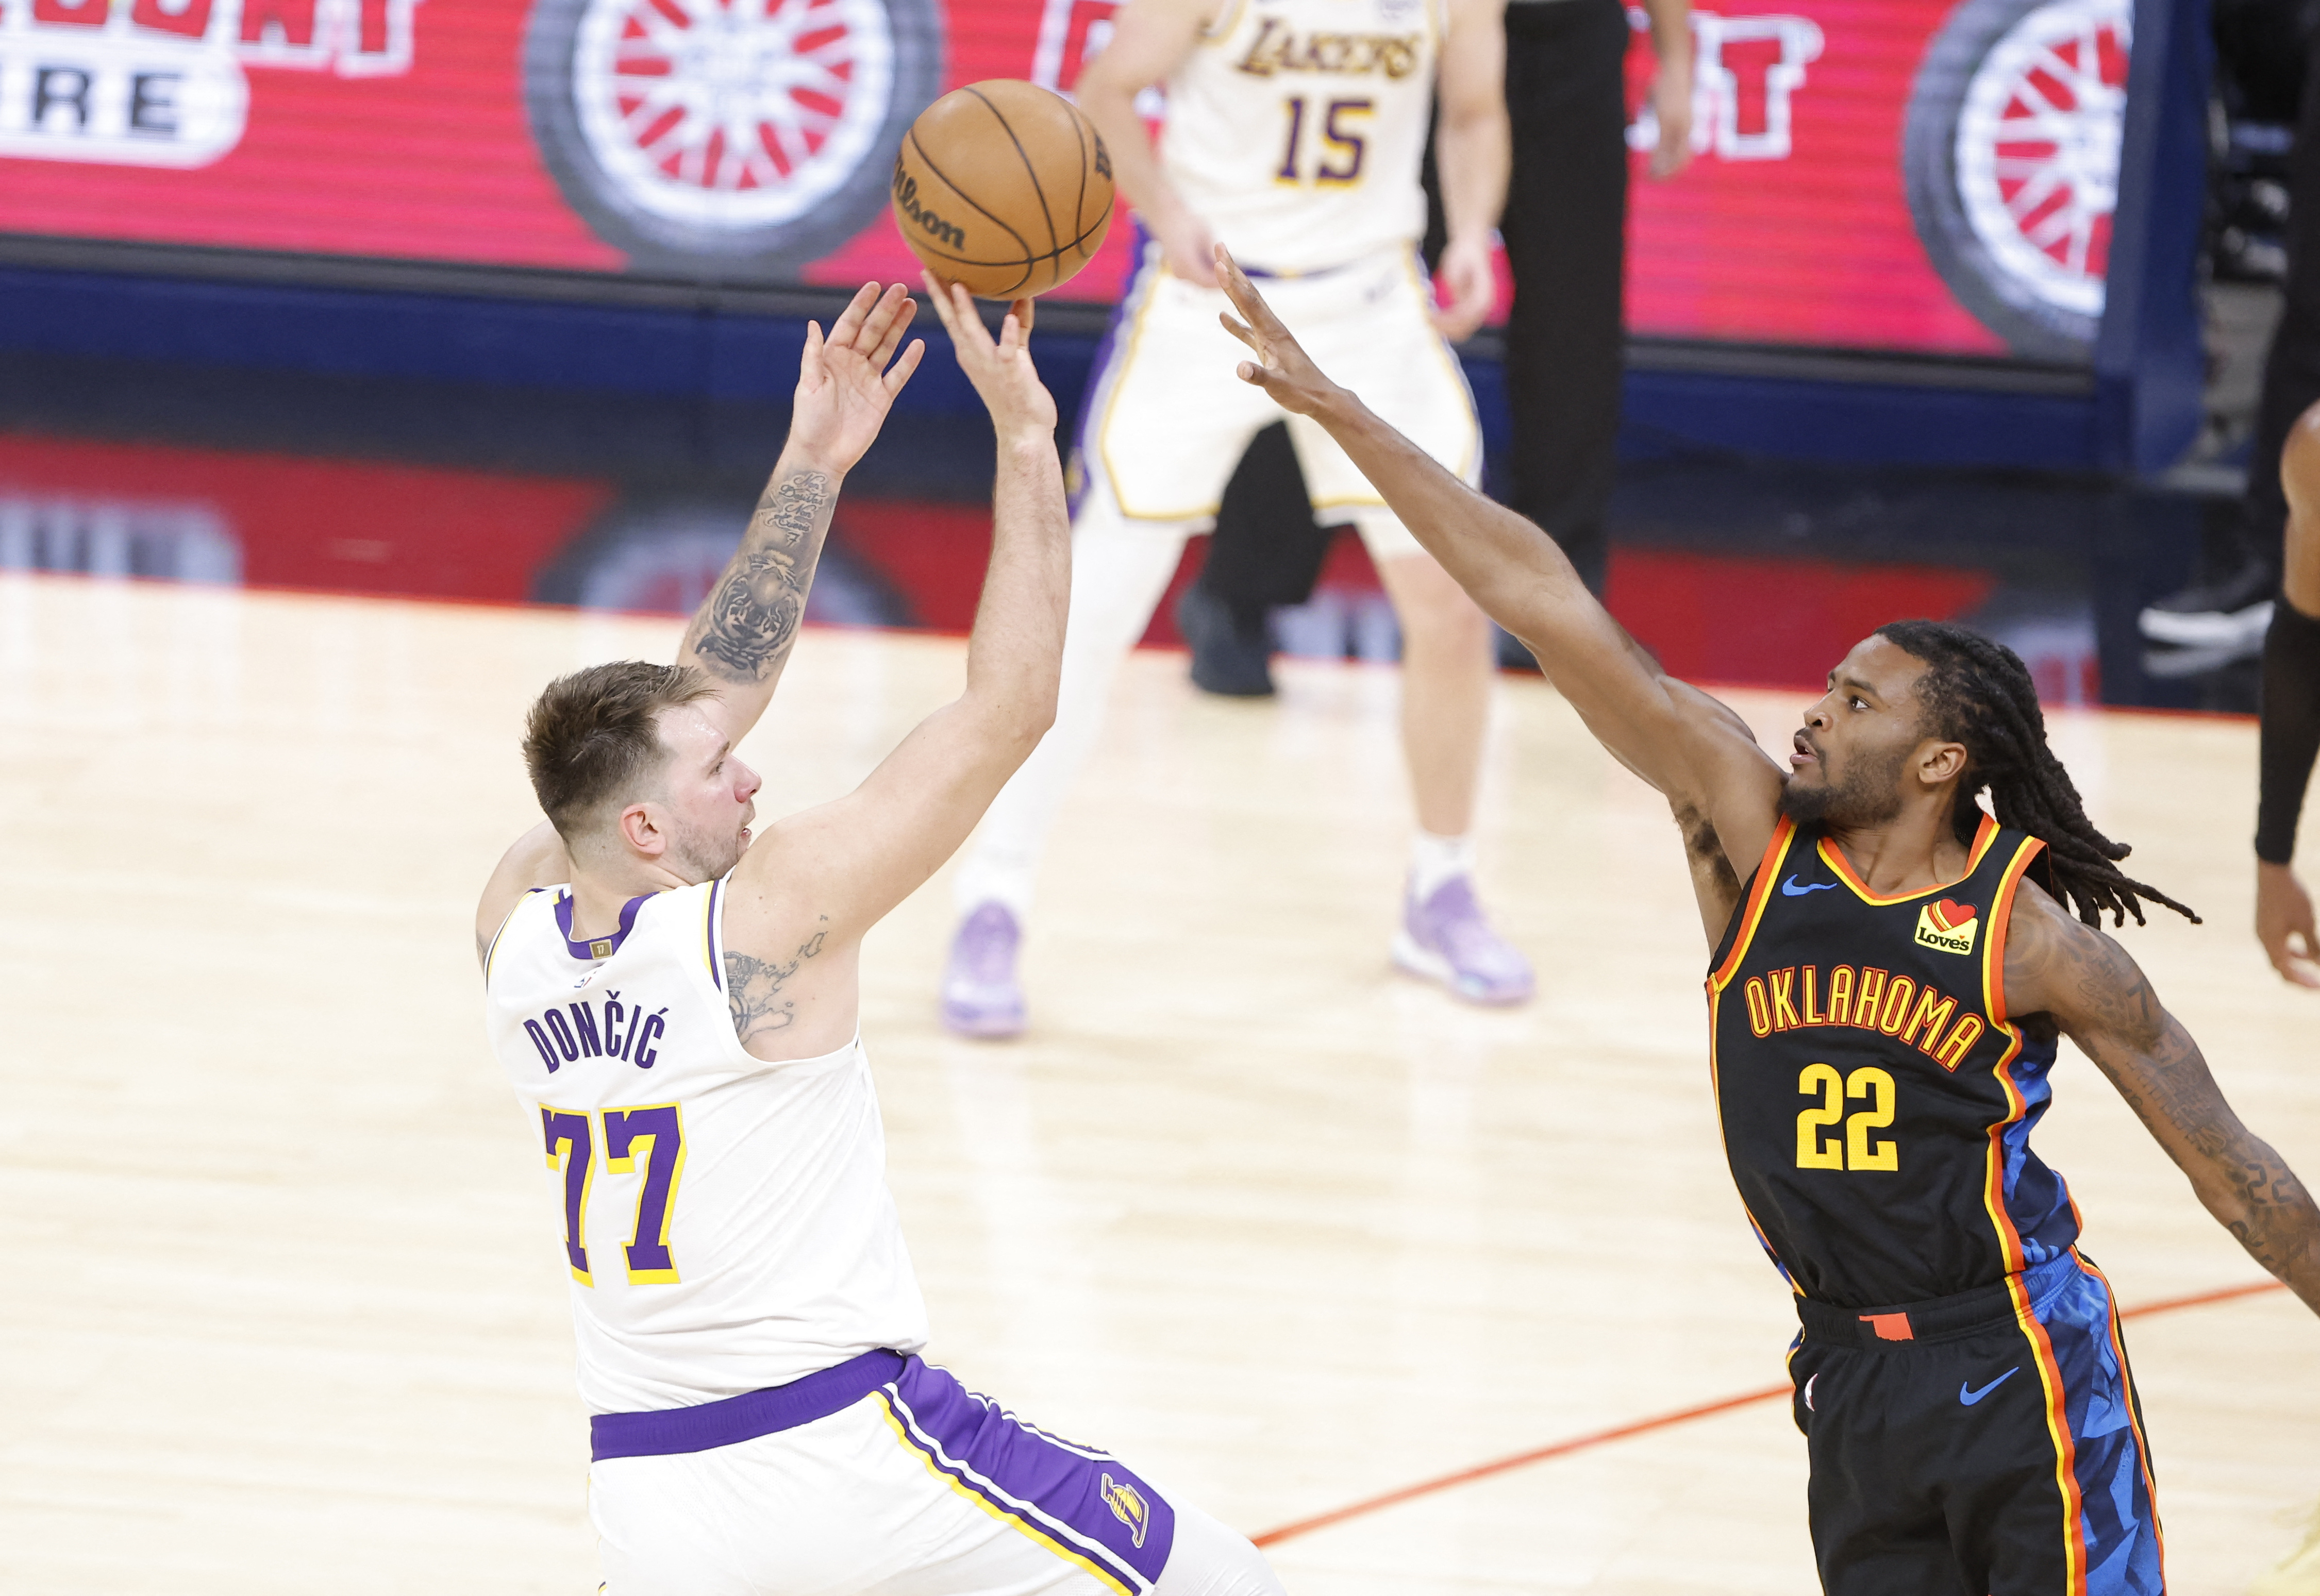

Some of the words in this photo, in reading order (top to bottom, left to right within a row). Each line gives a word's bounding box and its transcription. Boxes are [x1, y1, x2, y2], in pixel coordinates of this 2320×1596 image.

[1273, 98, 1375, 188] 15
[523, 989, 669, 1074] DONČIĆ
[1744, 964, 1984, 1072] OKLAHOMA
[1796, 1063, 1898, 1171] 22
[538, 1101, 687, 1288] 77
